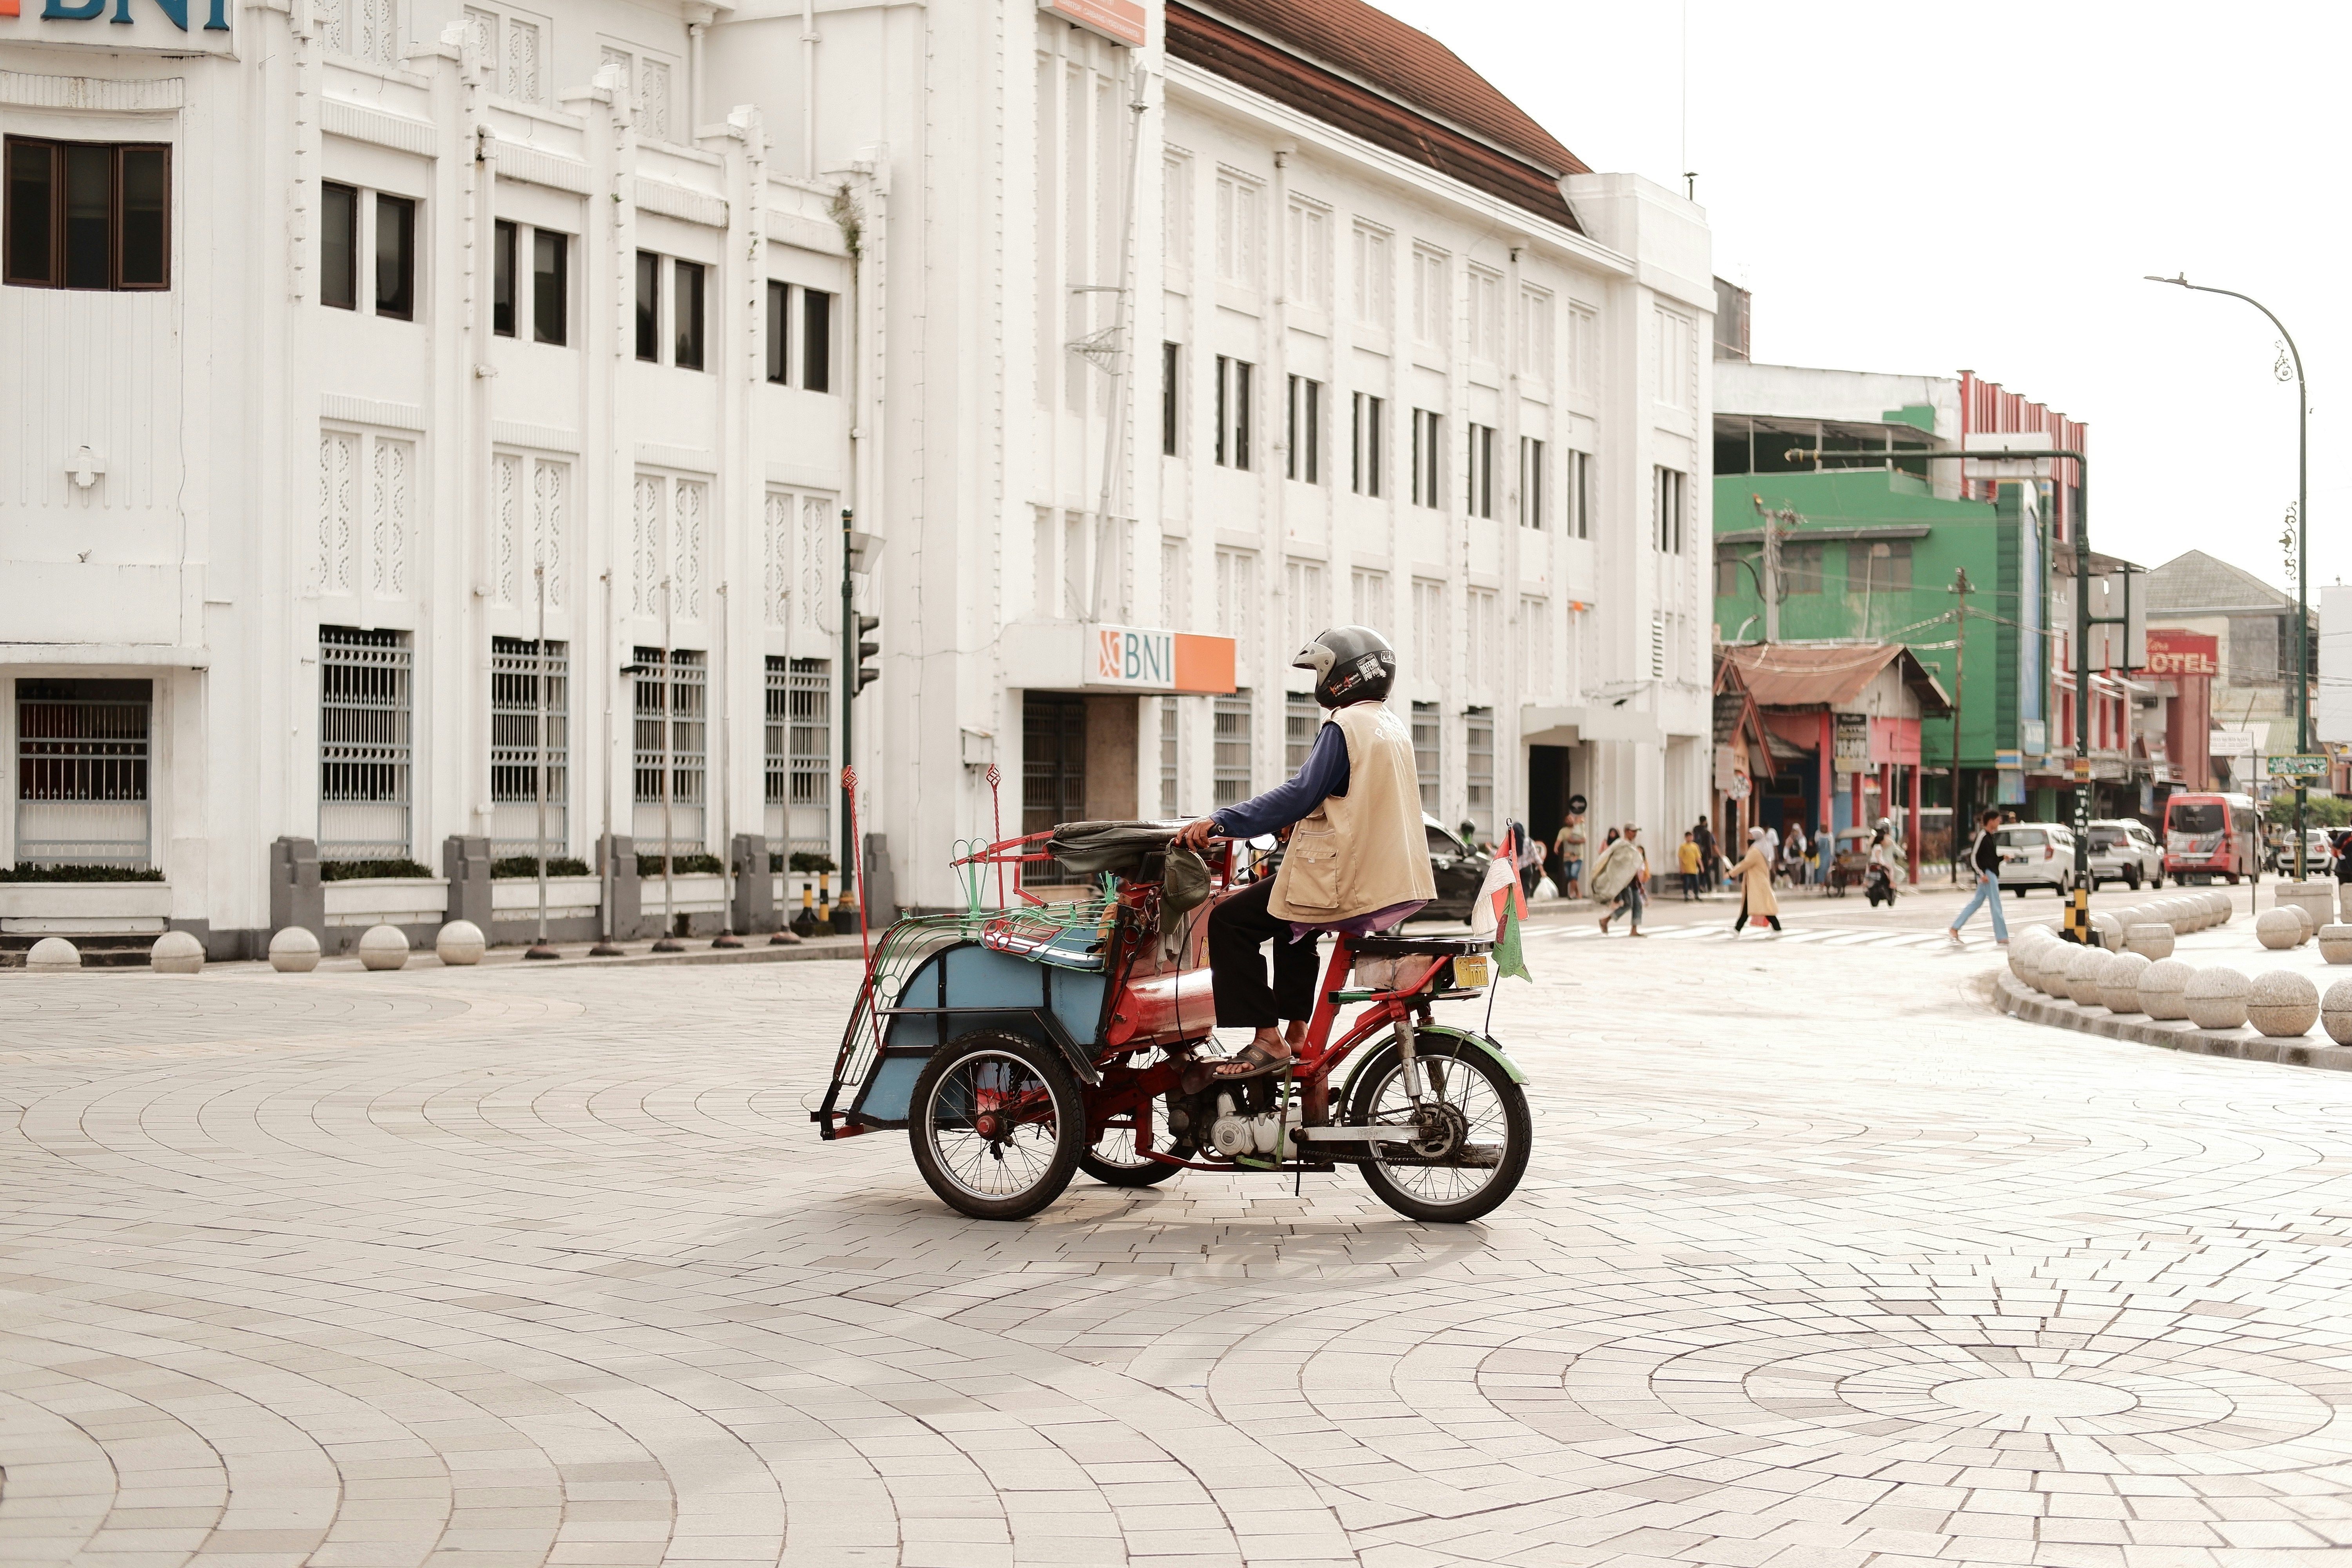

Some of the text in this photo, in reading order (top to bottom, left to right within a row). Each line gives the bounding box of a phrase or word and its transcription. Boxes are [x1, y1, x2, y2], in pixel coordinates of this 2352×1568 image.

[1125, 633, 1171, 682] BNI
[1382, 651, 1390, 659] POP
[1360, 659, 1378, 673] DEFEND
[1364, 671, 1373, 681] POP
